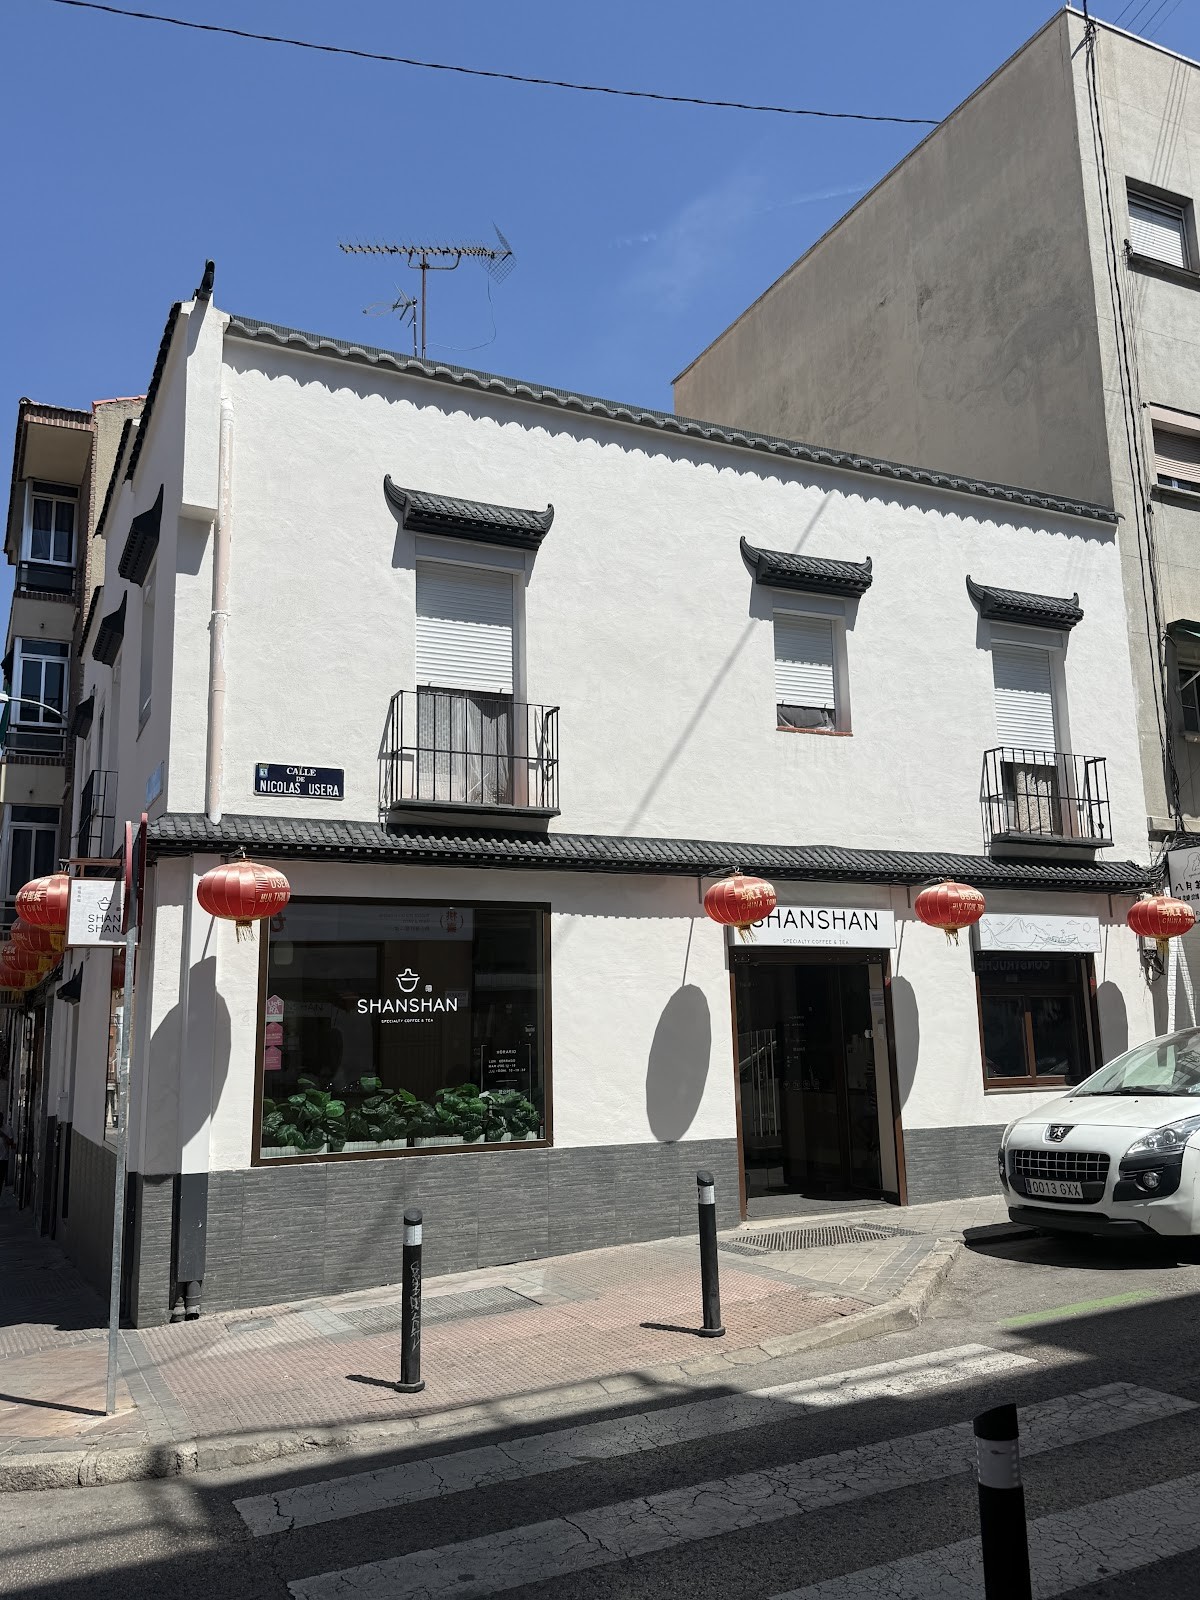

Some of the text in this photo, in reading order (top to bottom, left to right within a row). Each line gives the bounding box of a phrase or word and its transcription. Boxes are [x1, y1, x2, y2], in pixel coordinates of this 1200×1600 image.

[286, 767, 316, 776] CALLE
[260, 780, 339, 796] NICOLAS USERA
[23, 904, 42, 912] TOWN
[741, 900, 762, 910] CHINA
[88, 914, 121, 922] SHAN
[88, 924, 121, 933] SHAN
[357, 998, 458, 1013] SHANSHAN
[1033, 1181, 1080, 1196] 0013 GXX
